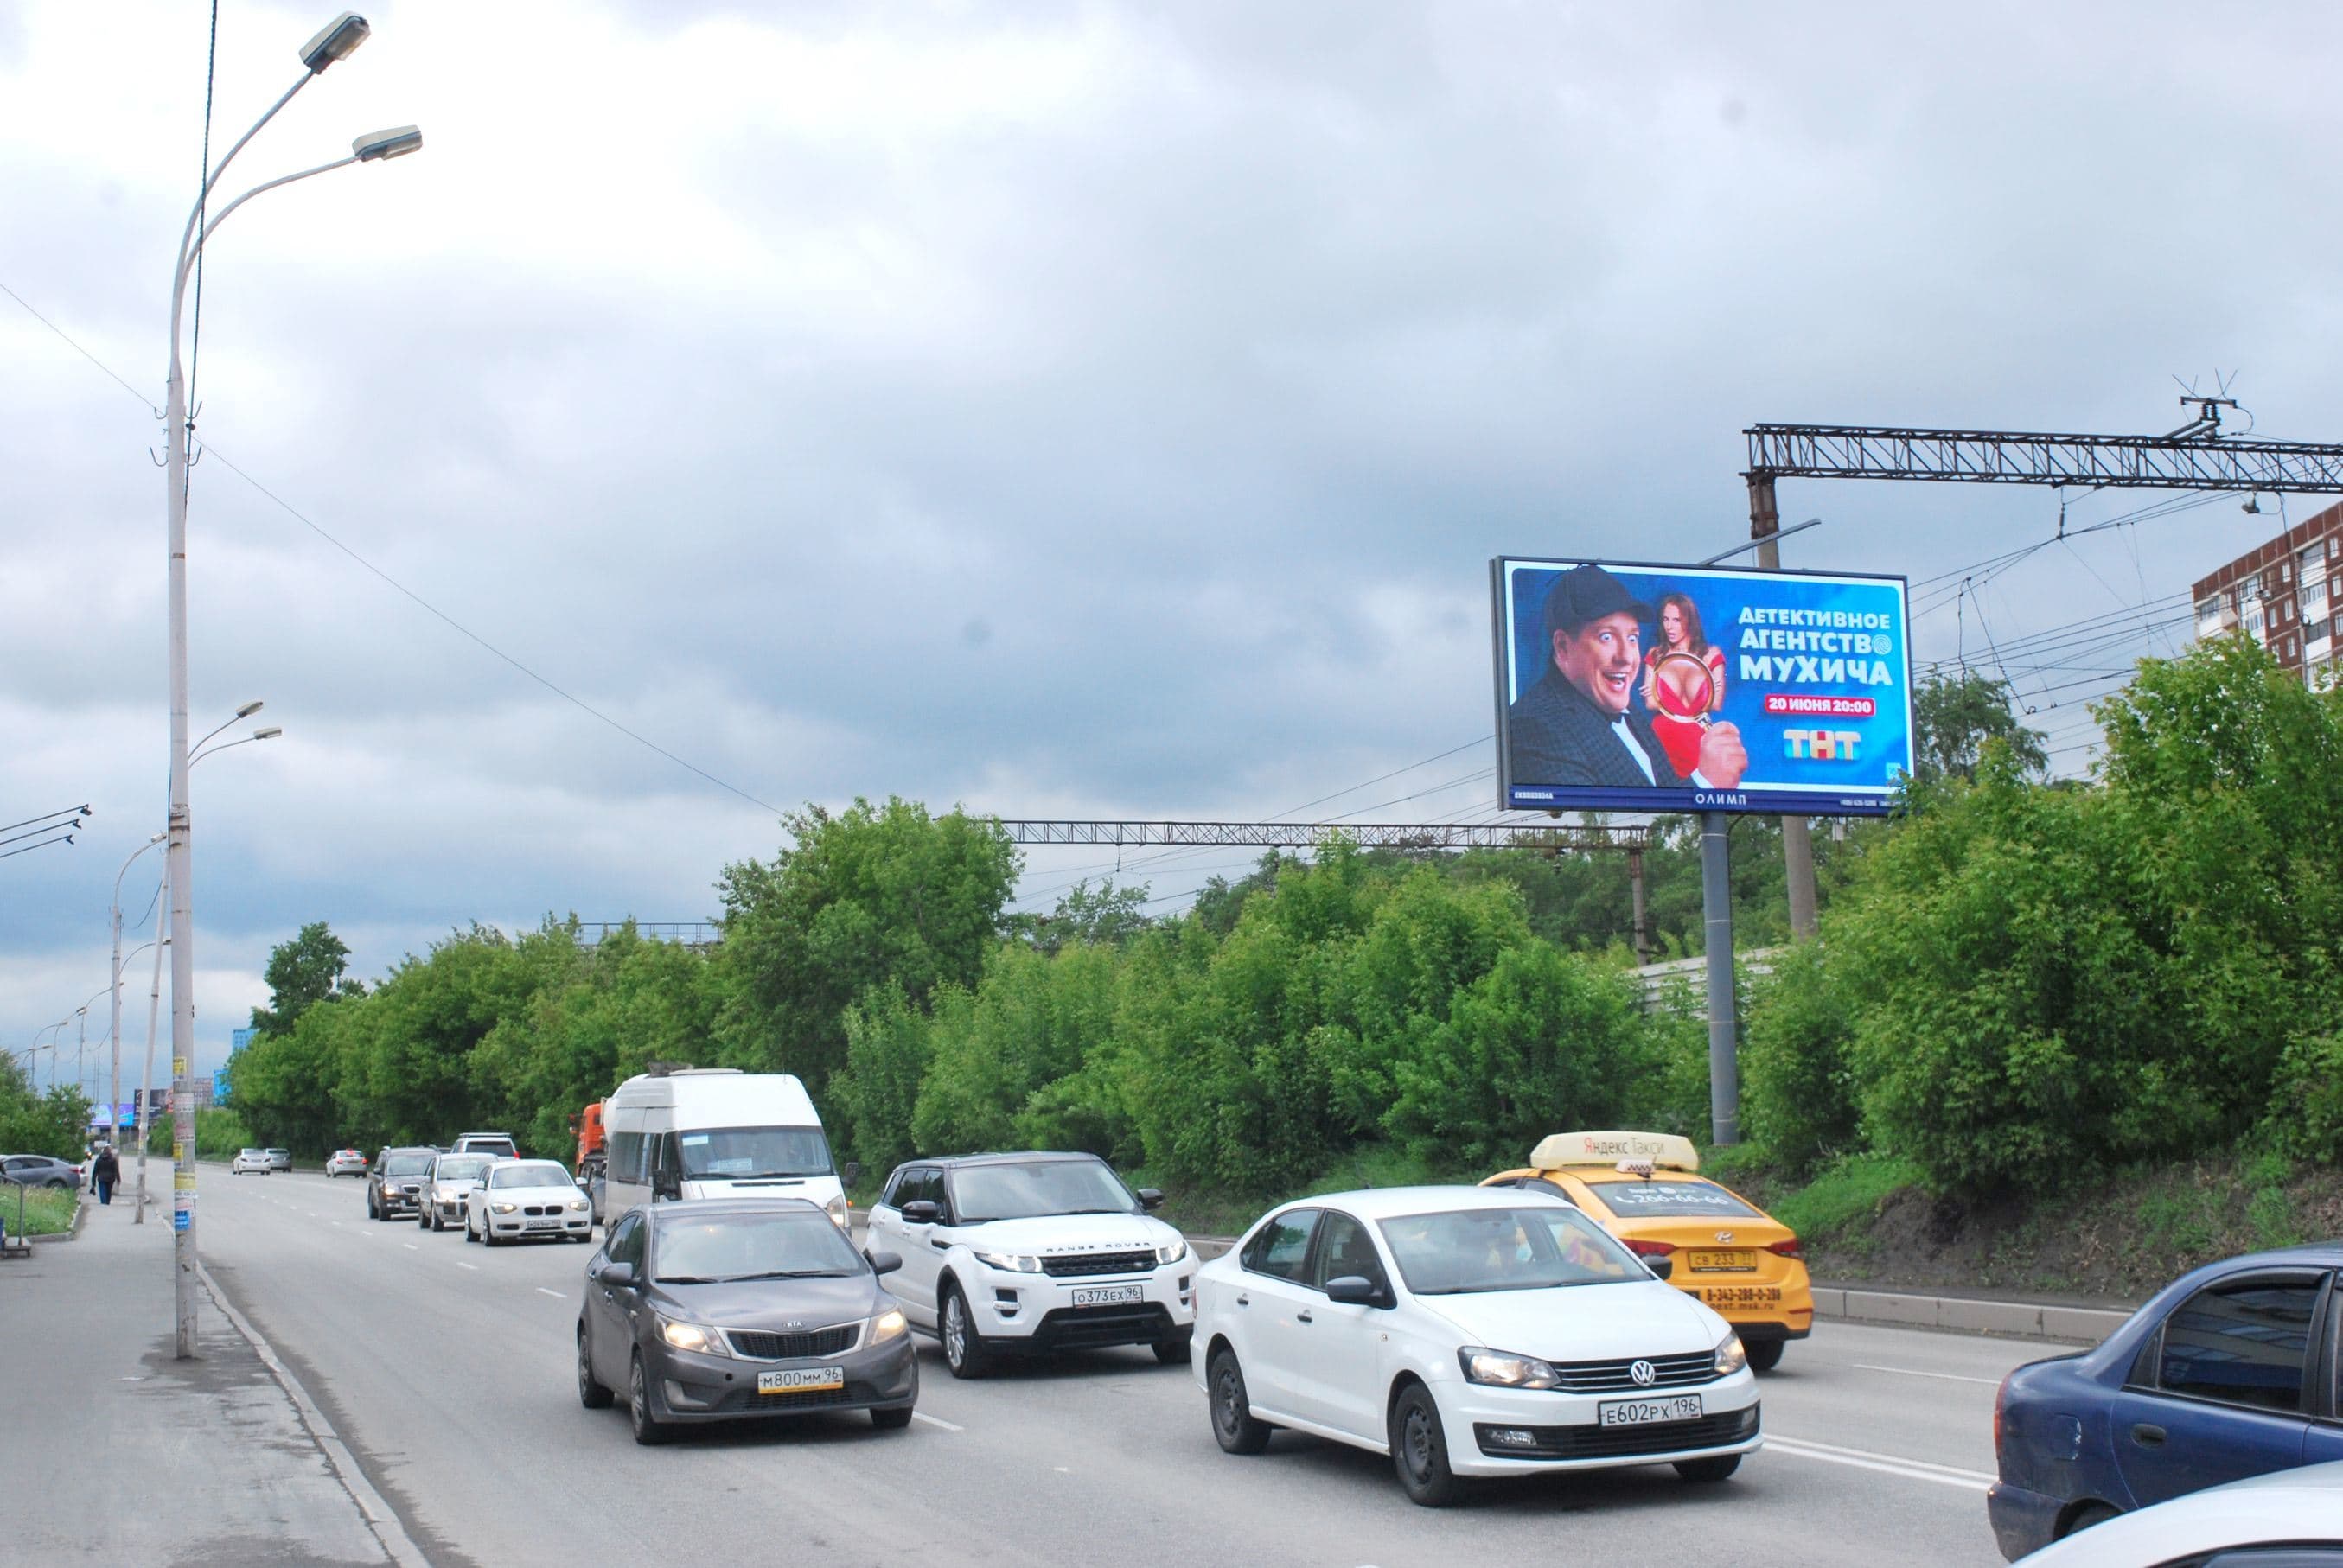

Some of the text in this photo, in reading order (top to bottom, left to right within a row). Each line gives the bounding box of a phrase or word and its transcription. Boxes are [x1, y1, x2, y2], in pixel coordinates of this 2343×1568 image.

[1738, 606, 1891, 629] ДЕТЕКТИВНОЕ
[1740, 655, 1893, 685] МУХИЧА
[1769, 698, 1872, 713] 20 ИЮНЯ 20:00
[1784, 729, 1861, 760] ТНТ
[1695, 794, 1746, 805] ОЛИМП
[1584, 1137, 1665, 1156] Яндекс Такси
[1127, 1287, 1138, 1297] 96
[825, 1368, 838, 1379] 96
[1673, 1399, 1697, 1412] 196
